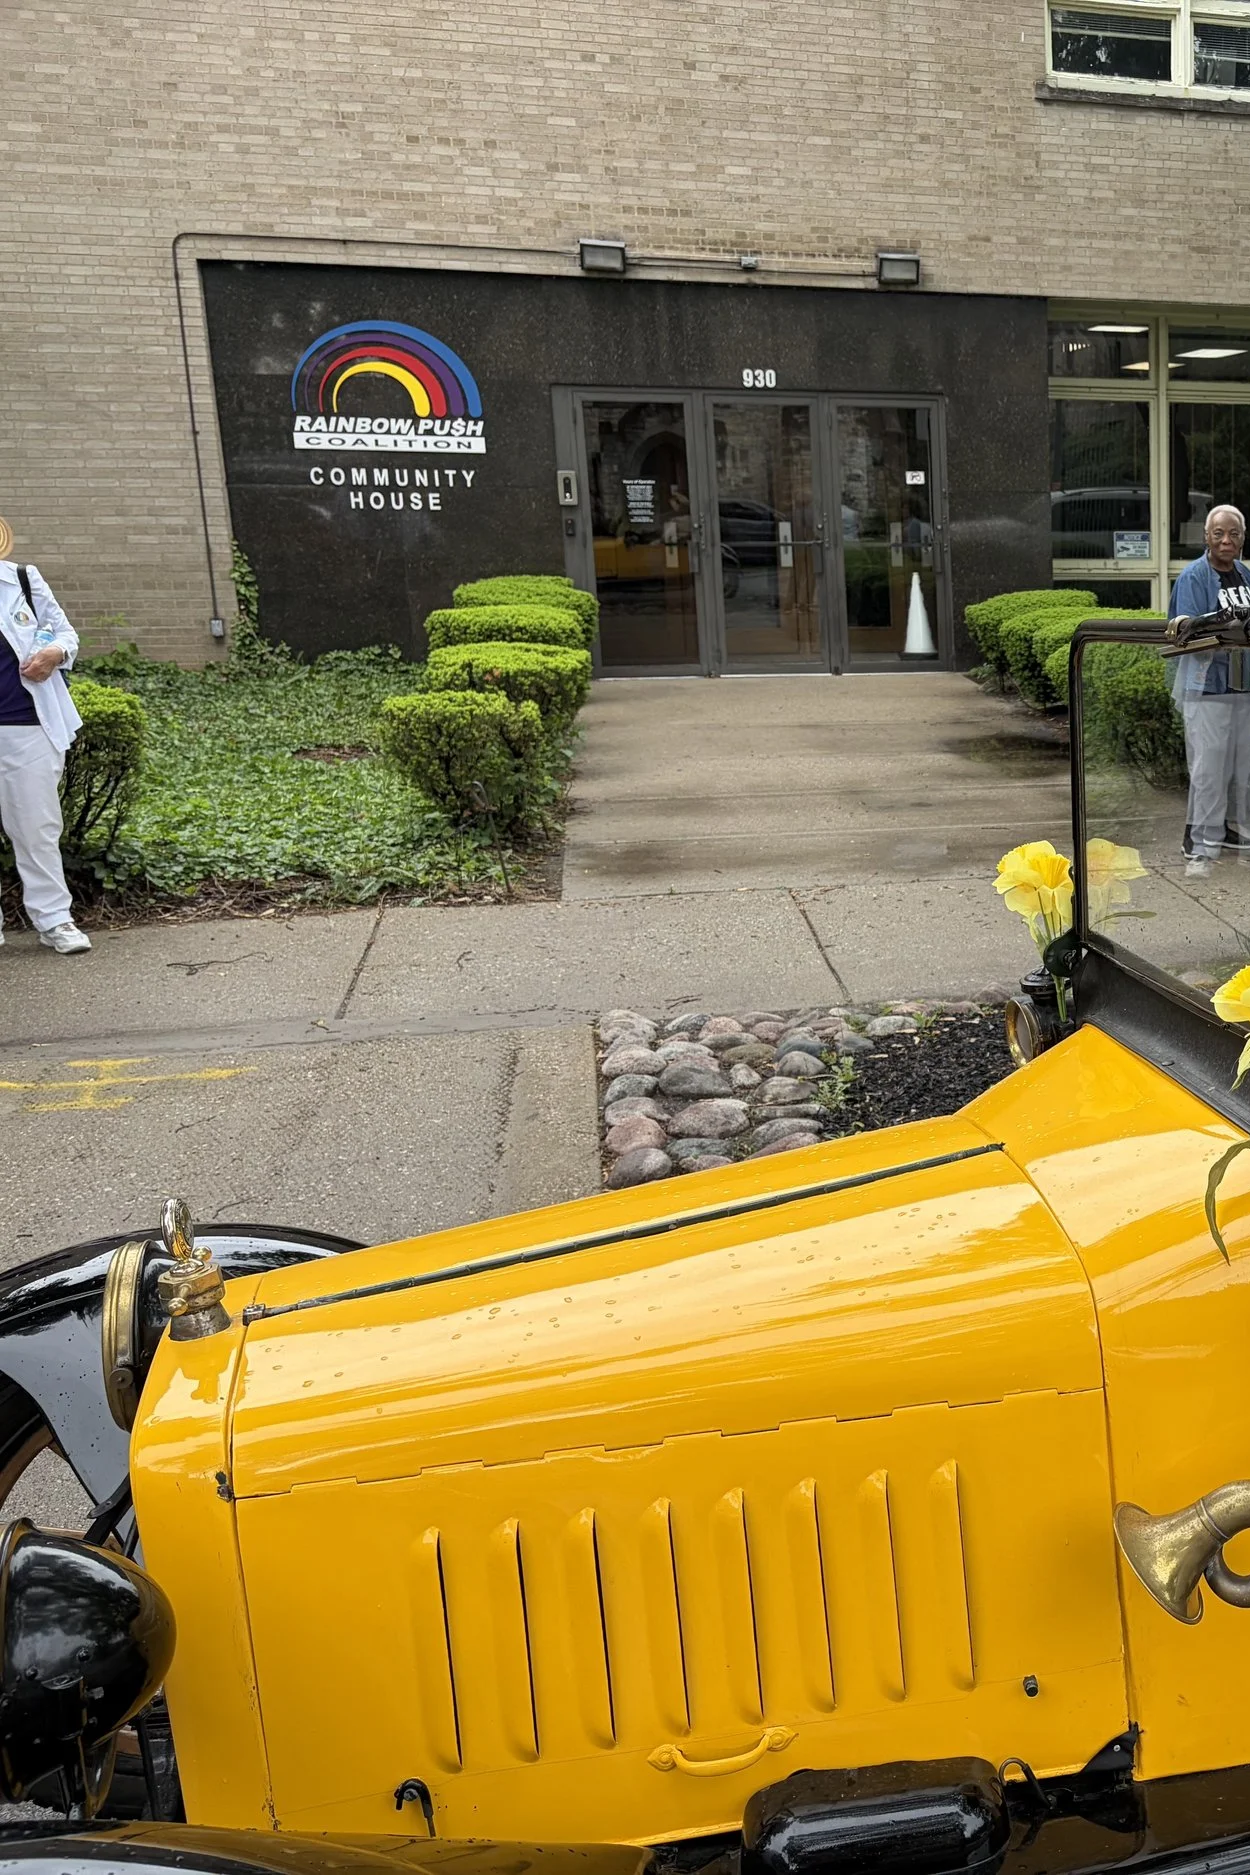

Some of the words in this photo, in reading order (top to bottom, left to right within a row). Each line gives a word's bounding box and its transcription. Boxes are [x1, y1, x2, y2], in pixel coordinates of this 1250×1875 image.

[742, 368, 777, 388] 930
[294, 415, 414, 435] RAINBOW
[305, 436, 473, 450] COALITION
[309, 467, 476, 488] COMMUNITY
[349, 491, 442, 511] HOUSE
